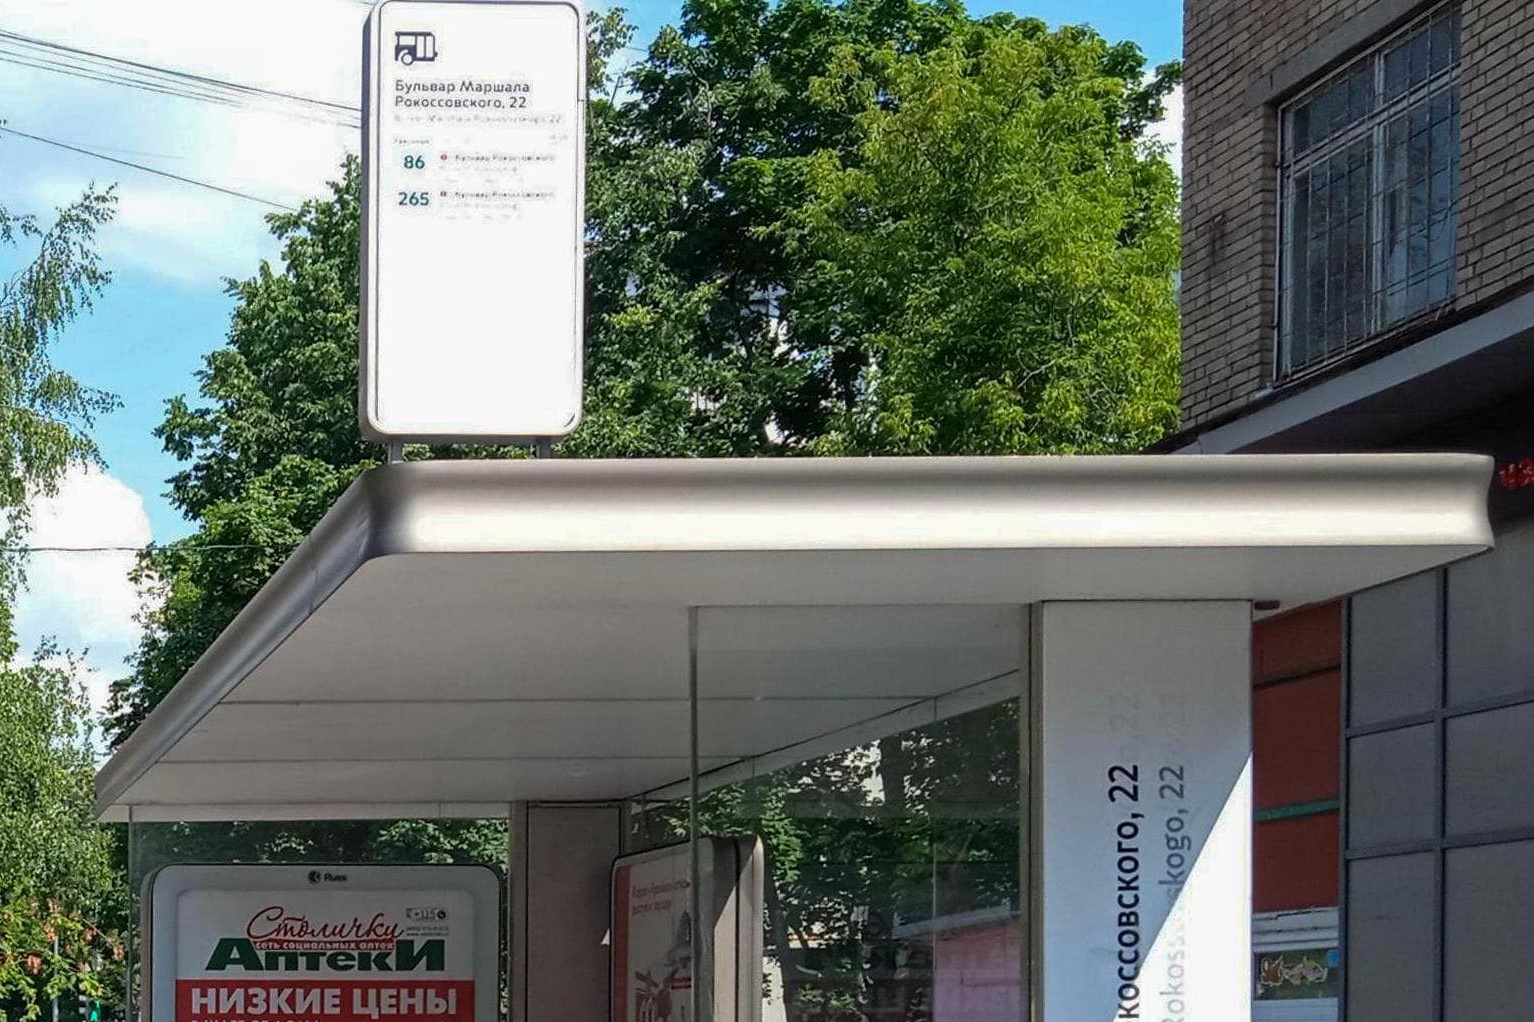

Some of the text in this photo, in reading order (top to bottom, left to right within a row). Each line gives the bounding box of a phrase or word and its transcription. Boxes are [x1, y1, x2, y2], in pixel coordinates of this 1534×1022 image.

[395, 79, 530, 94] Бульвар Маршала
[395, 95, 527, 109] Рокоссовского, 22
[403, 155, 426, 170] 86
[398, 192, 430, 206] 265
[1108, 764, 1139, 803] 22
[1158, 765, 1185, 800] 22
[246, 905, 404, 940] Столички
[255, 941, 395, 951] сеть социальных аптек
[191, 987, 457, 1019] НИЗКИЕ ЦЕНЫ
